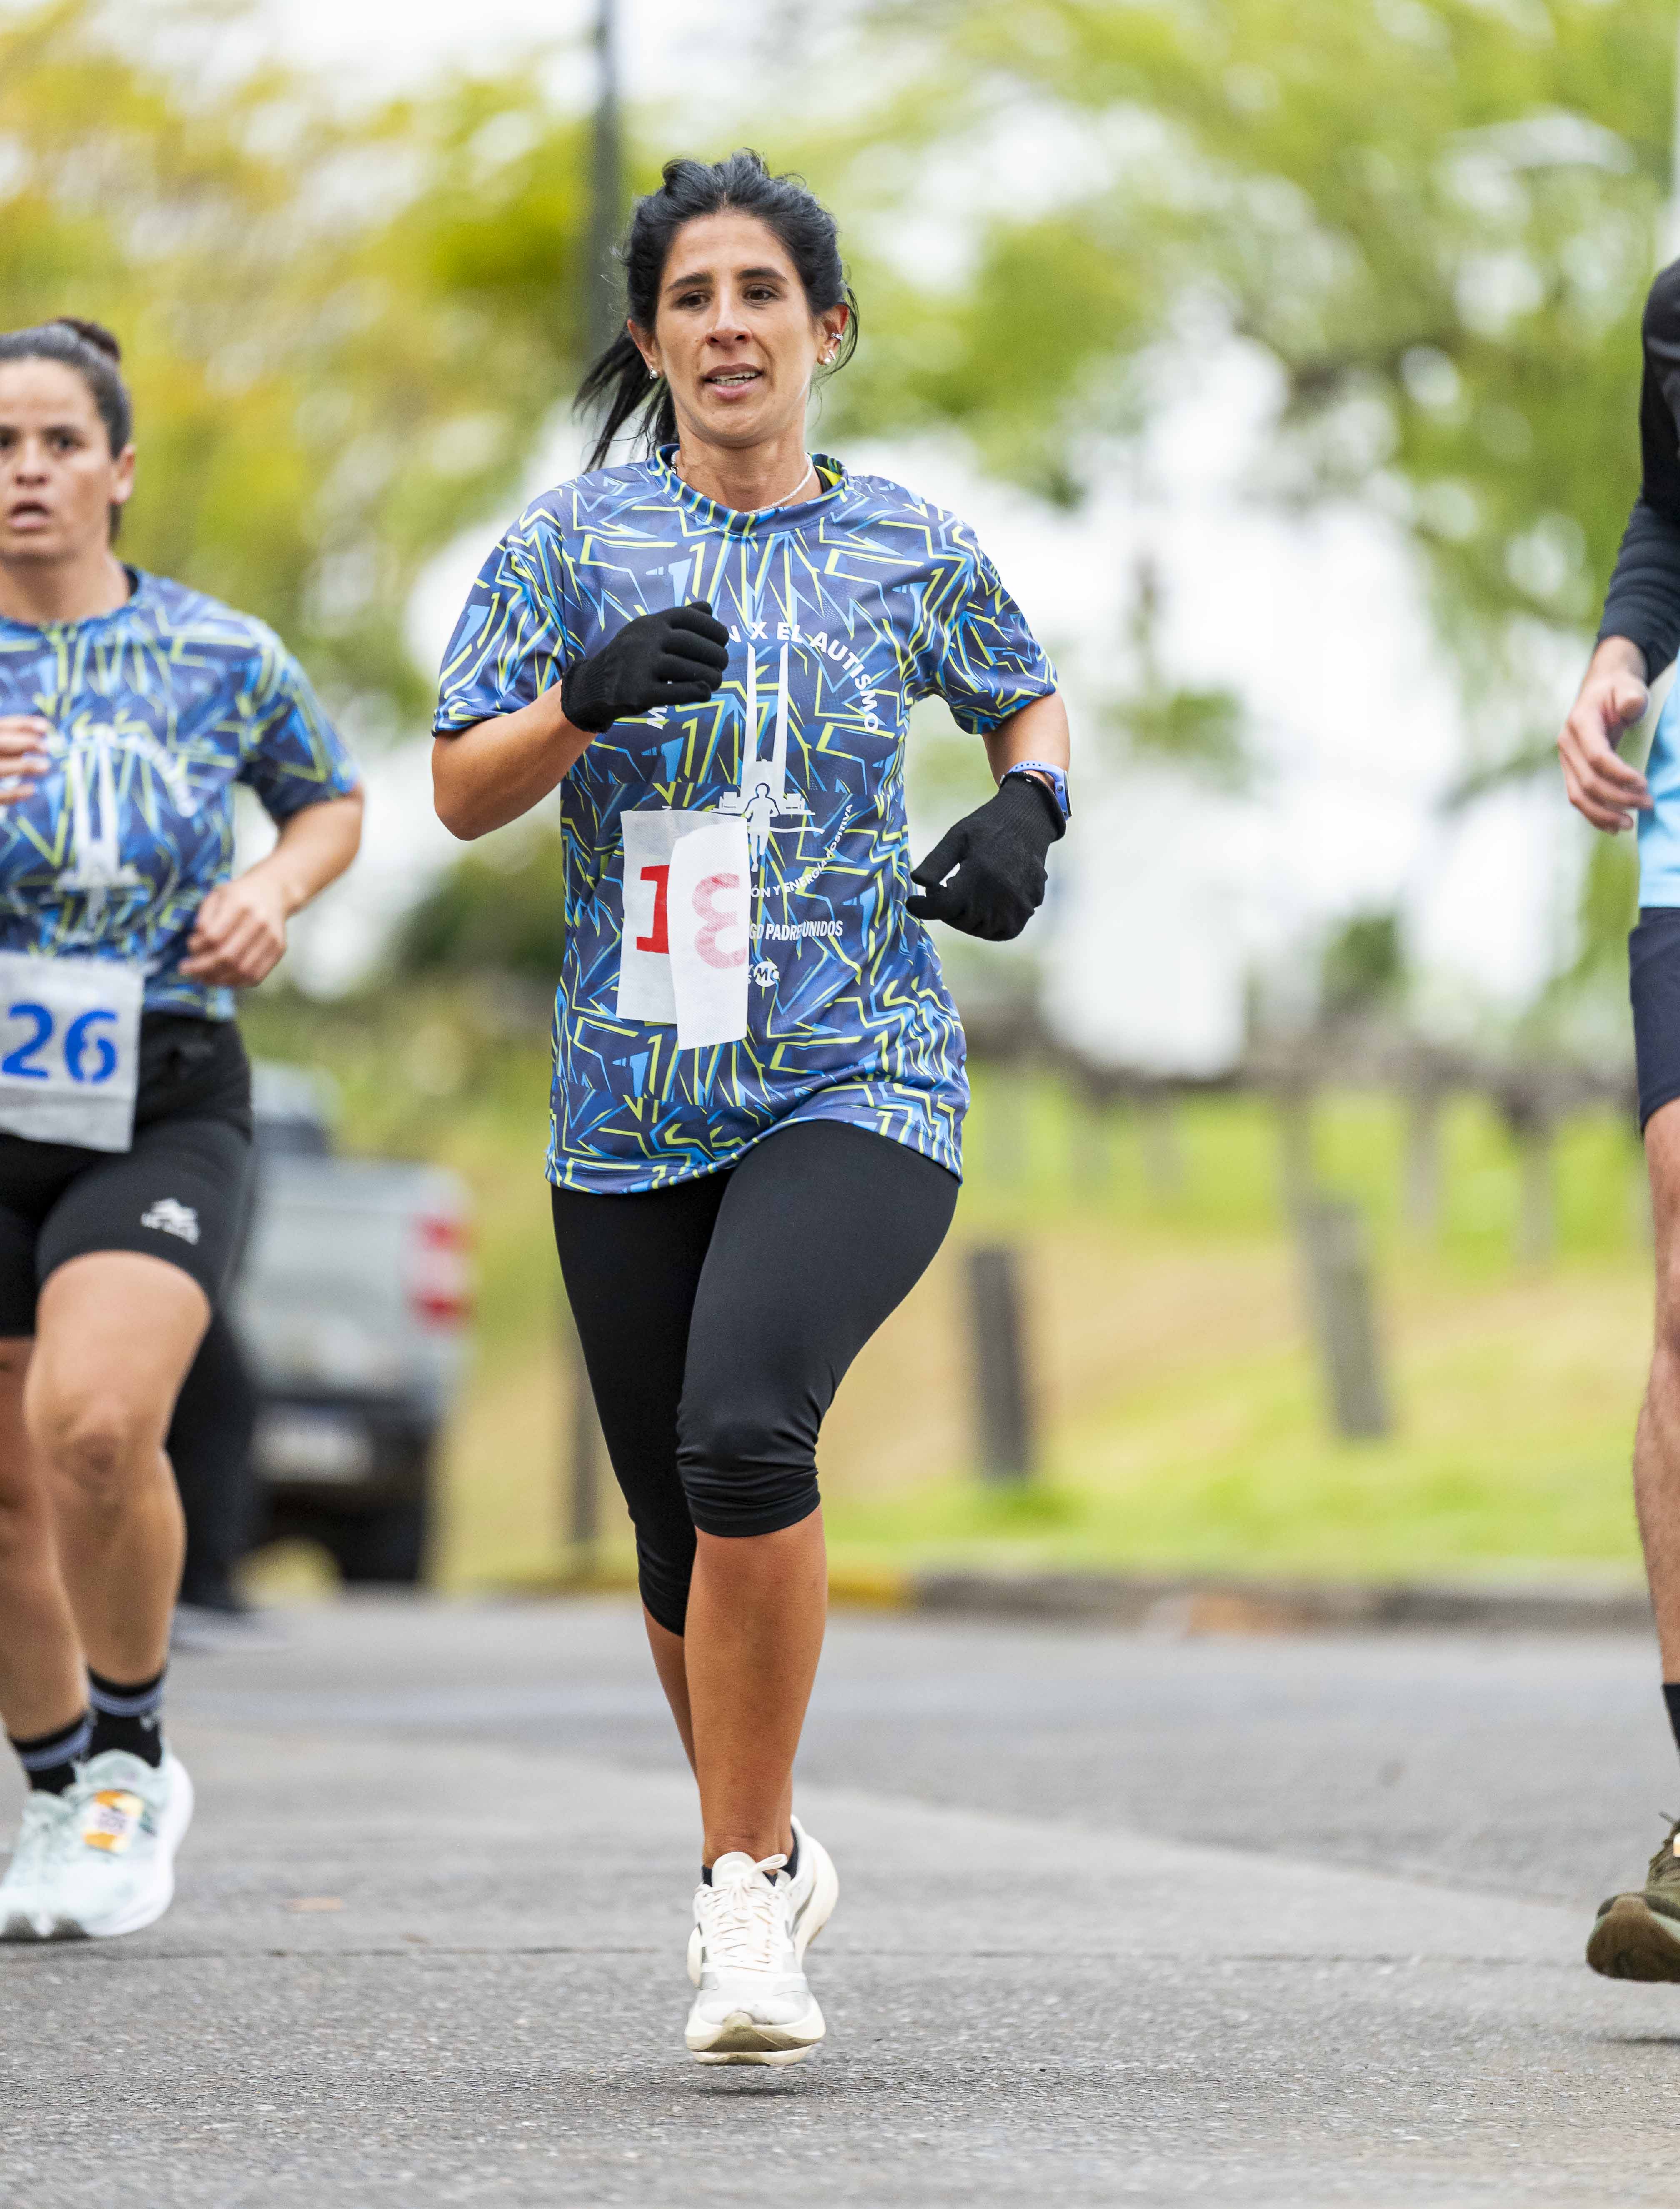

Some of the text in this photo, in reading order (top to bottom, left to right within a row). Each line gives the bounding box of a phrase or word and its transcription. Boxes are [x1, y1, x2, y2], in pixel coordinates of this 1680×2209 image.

[750, 622, 769, 640] X
[777, 622, 803, 643] EL
[809, 631, 879, 733] AUTISMO
[751, 884, 771, 898] ÓN
[772, 885, 780, 896] Y
[784, 860, 828, 893] ENERGÍA
[749, 920, 844, 941] GD PADRE UNIDOS
[2, 1003, 118, 1084] 26
